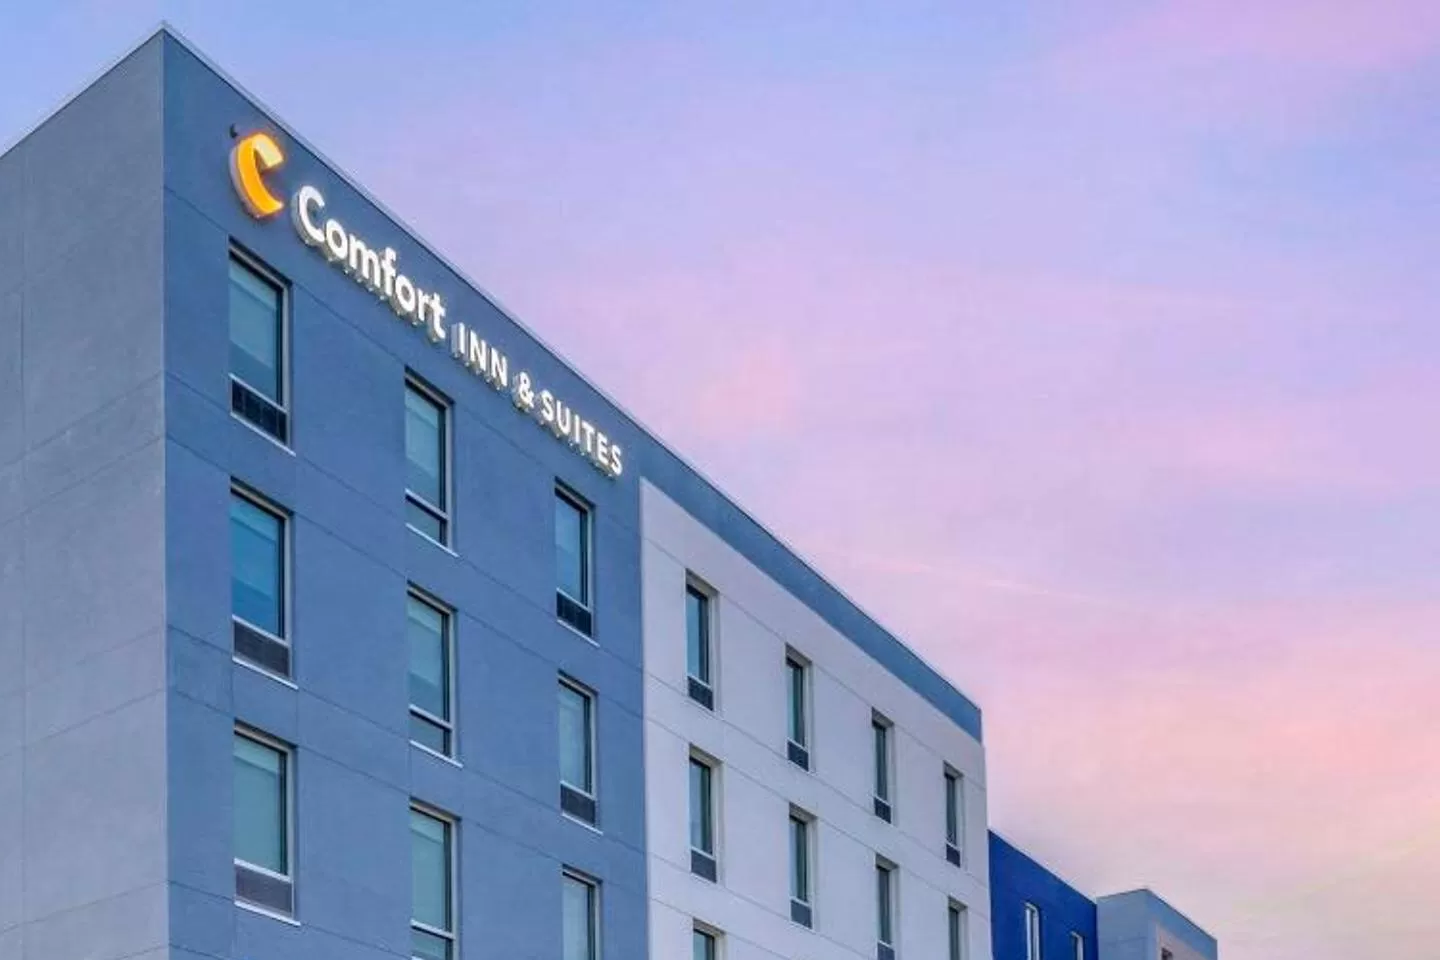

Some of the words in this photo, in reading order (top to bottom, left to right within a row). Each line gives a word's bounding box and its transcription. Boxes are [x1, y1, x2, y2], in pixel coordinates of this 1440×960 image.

[292, 185, 447, 342] Comfort
[452, 322, 509, 390] INN
[514, 371, 535, 411] &
[539, 389, 622, 478] SUITES
